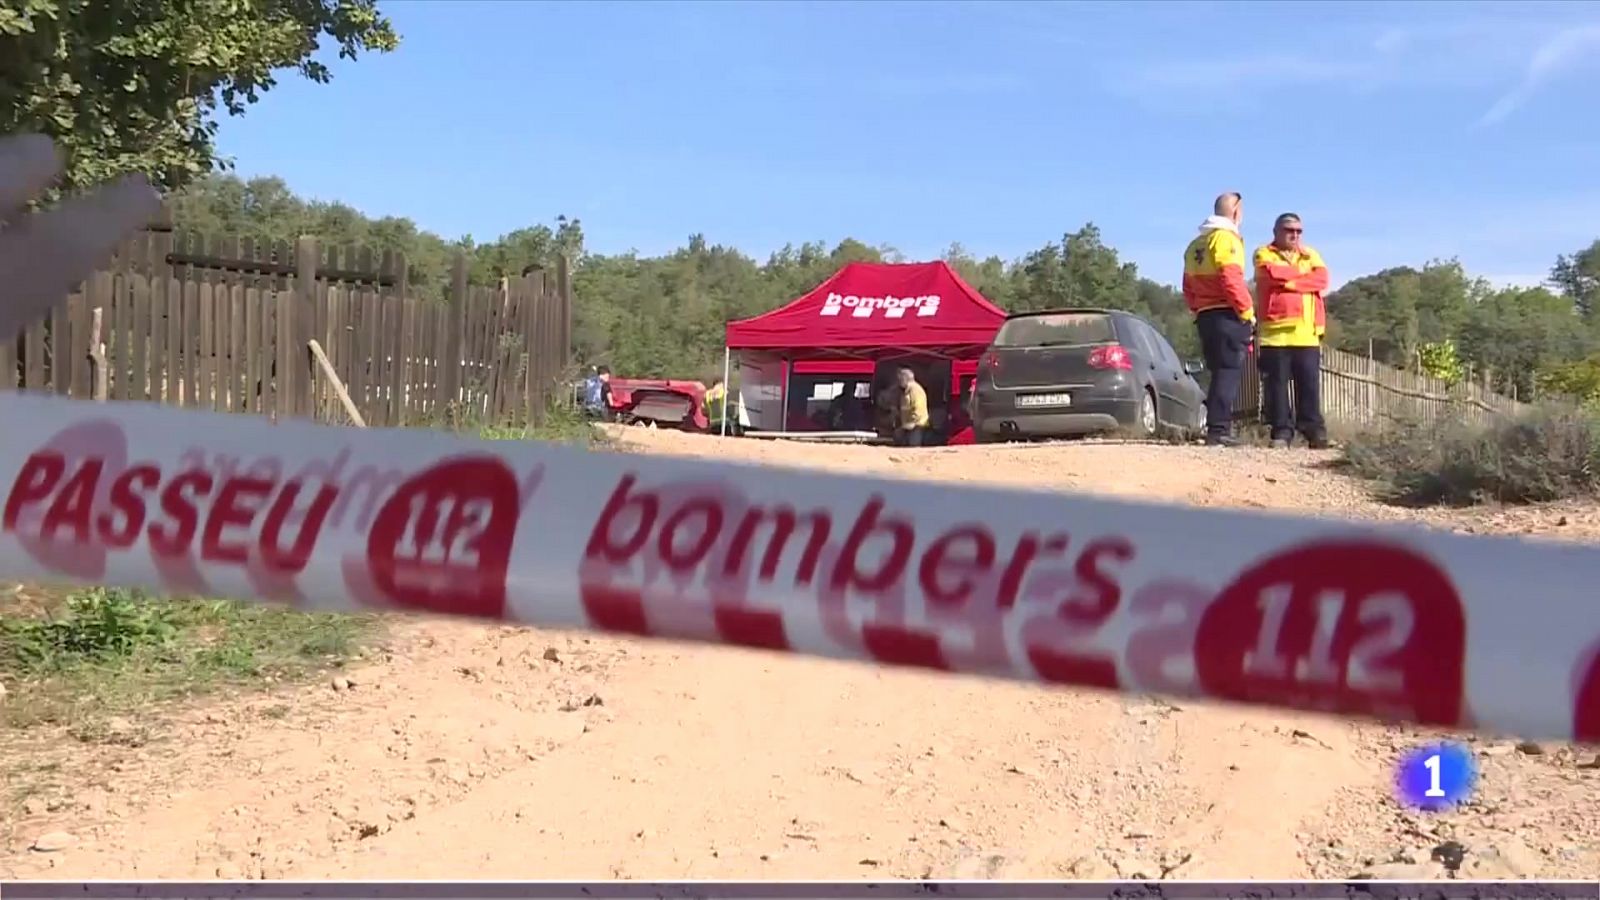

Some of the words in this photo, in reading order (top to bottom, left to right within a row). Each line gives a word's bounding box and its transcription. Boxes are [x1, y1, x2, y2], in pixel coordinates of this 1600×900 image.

[826, 292, 941, 310] bombers
[2, 446, 338, 573] PASSEU
[392, 490, 494, 568] 112
[585, 473, 1137, 624] bombers
[1242, 583, 1416, 692] 112
